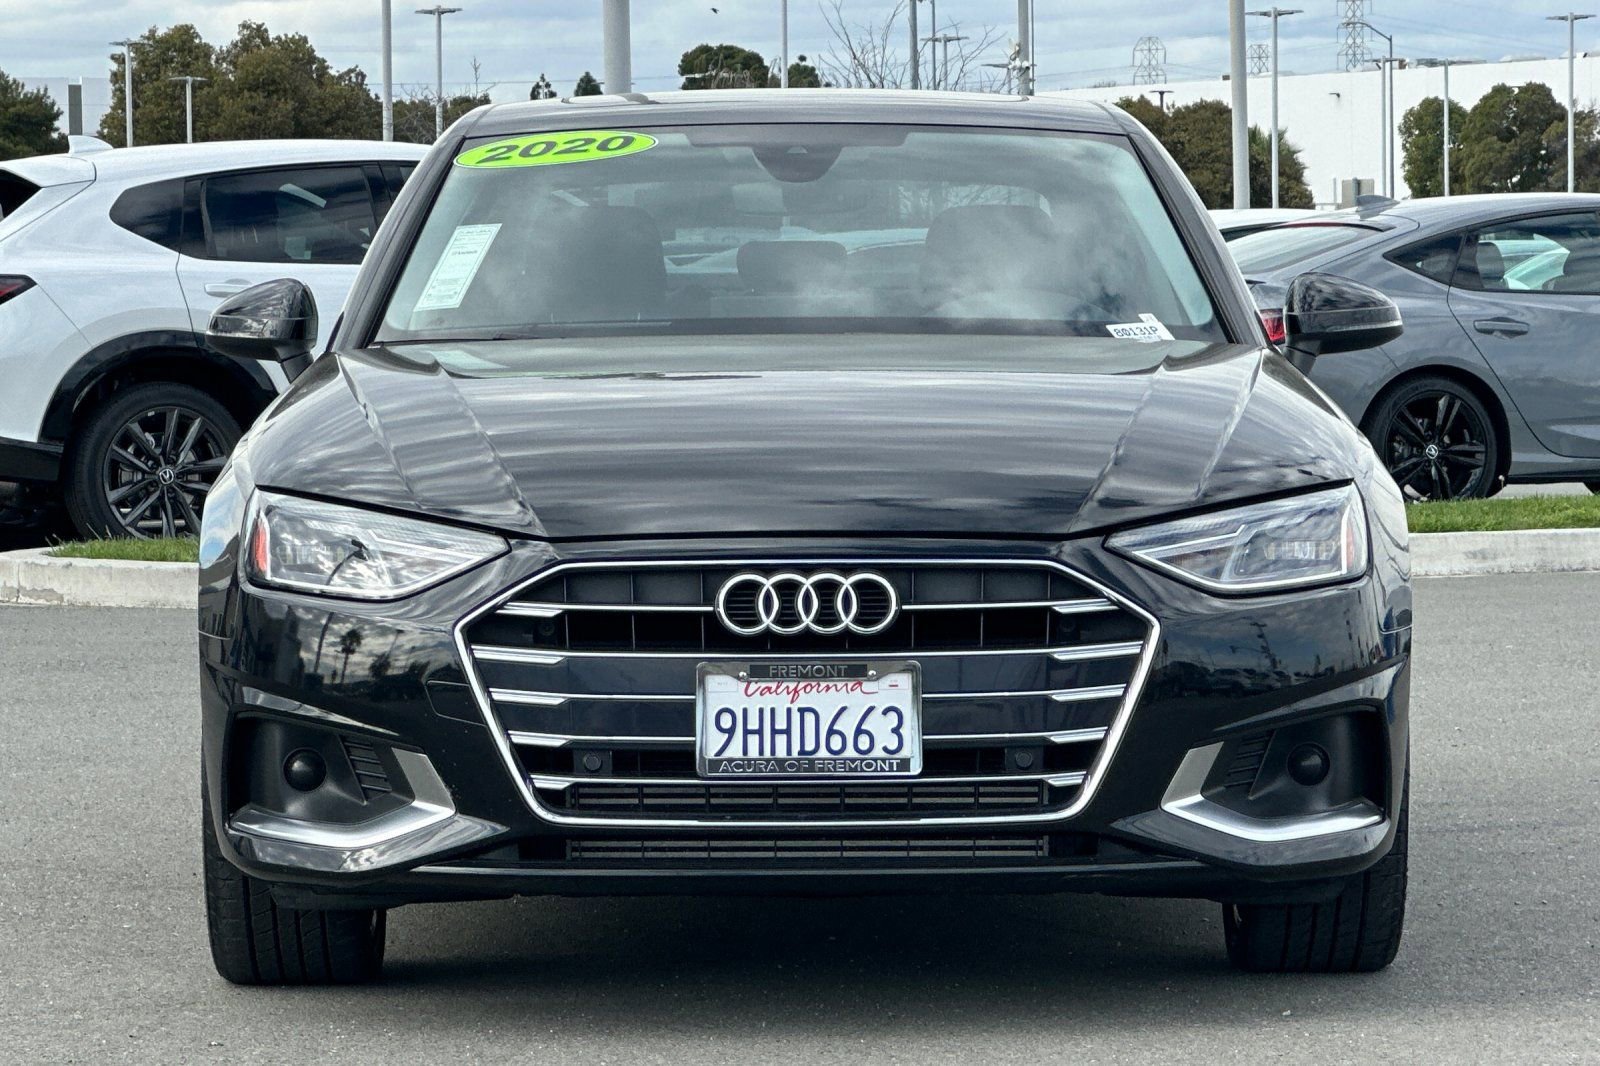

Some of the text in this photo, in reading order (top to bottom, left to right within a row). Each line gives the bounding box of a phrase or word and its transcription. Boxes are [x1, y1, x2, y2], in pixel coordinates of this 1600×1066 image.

[475, 136, 635, 164] 2020
[769, 665, 848, 678] FREMONT
[744, 680, 878, 704] California
[713, 705, 904, 757] 9HHD663
[718, 759, 901, 773] ACURA OF FREMONT
